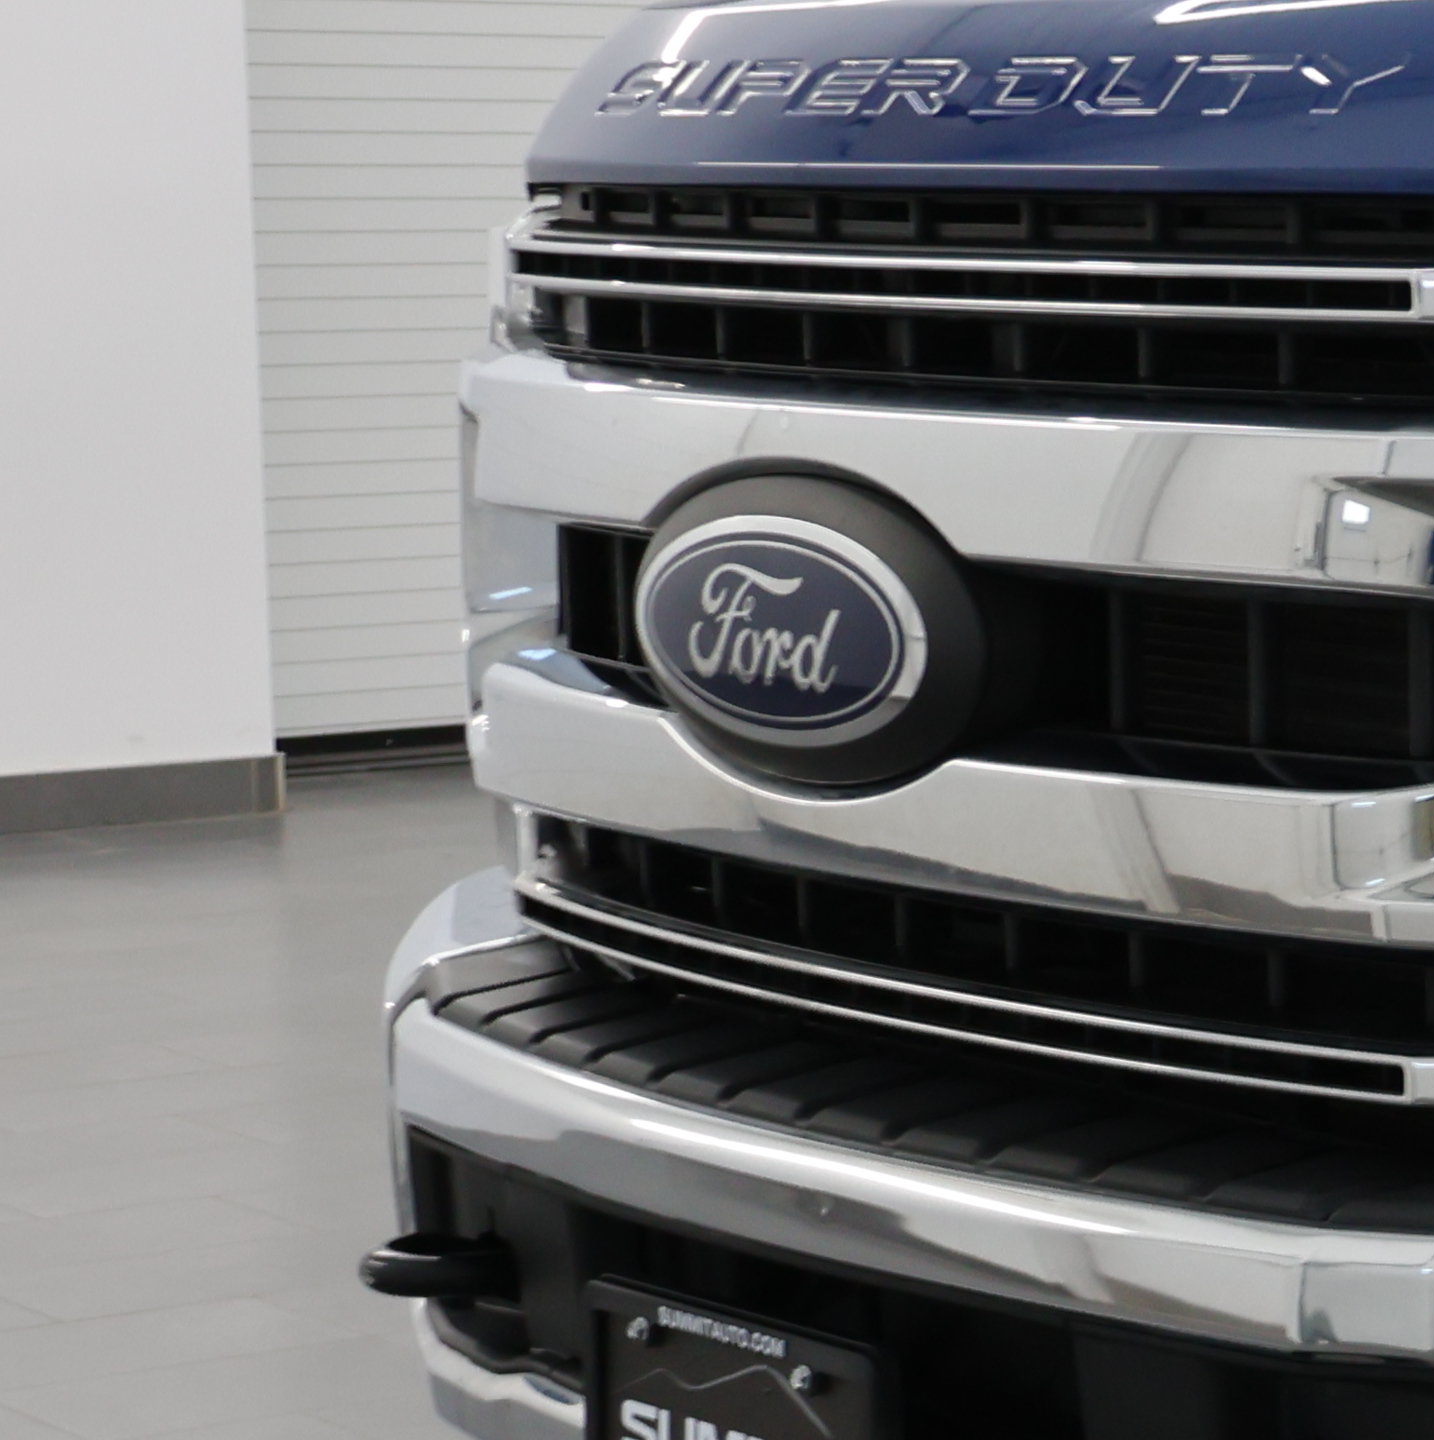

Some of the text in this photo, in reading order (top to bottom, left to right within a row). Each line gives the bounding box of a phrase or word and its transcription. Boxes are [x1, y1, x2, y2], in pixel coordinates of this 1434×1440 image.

[594, 53, 1412, 118] SUPER DUTY
[687, 562, 843, 694] Ford
[657, 1305, 787, 1358] SUMMITAUTO.COM
